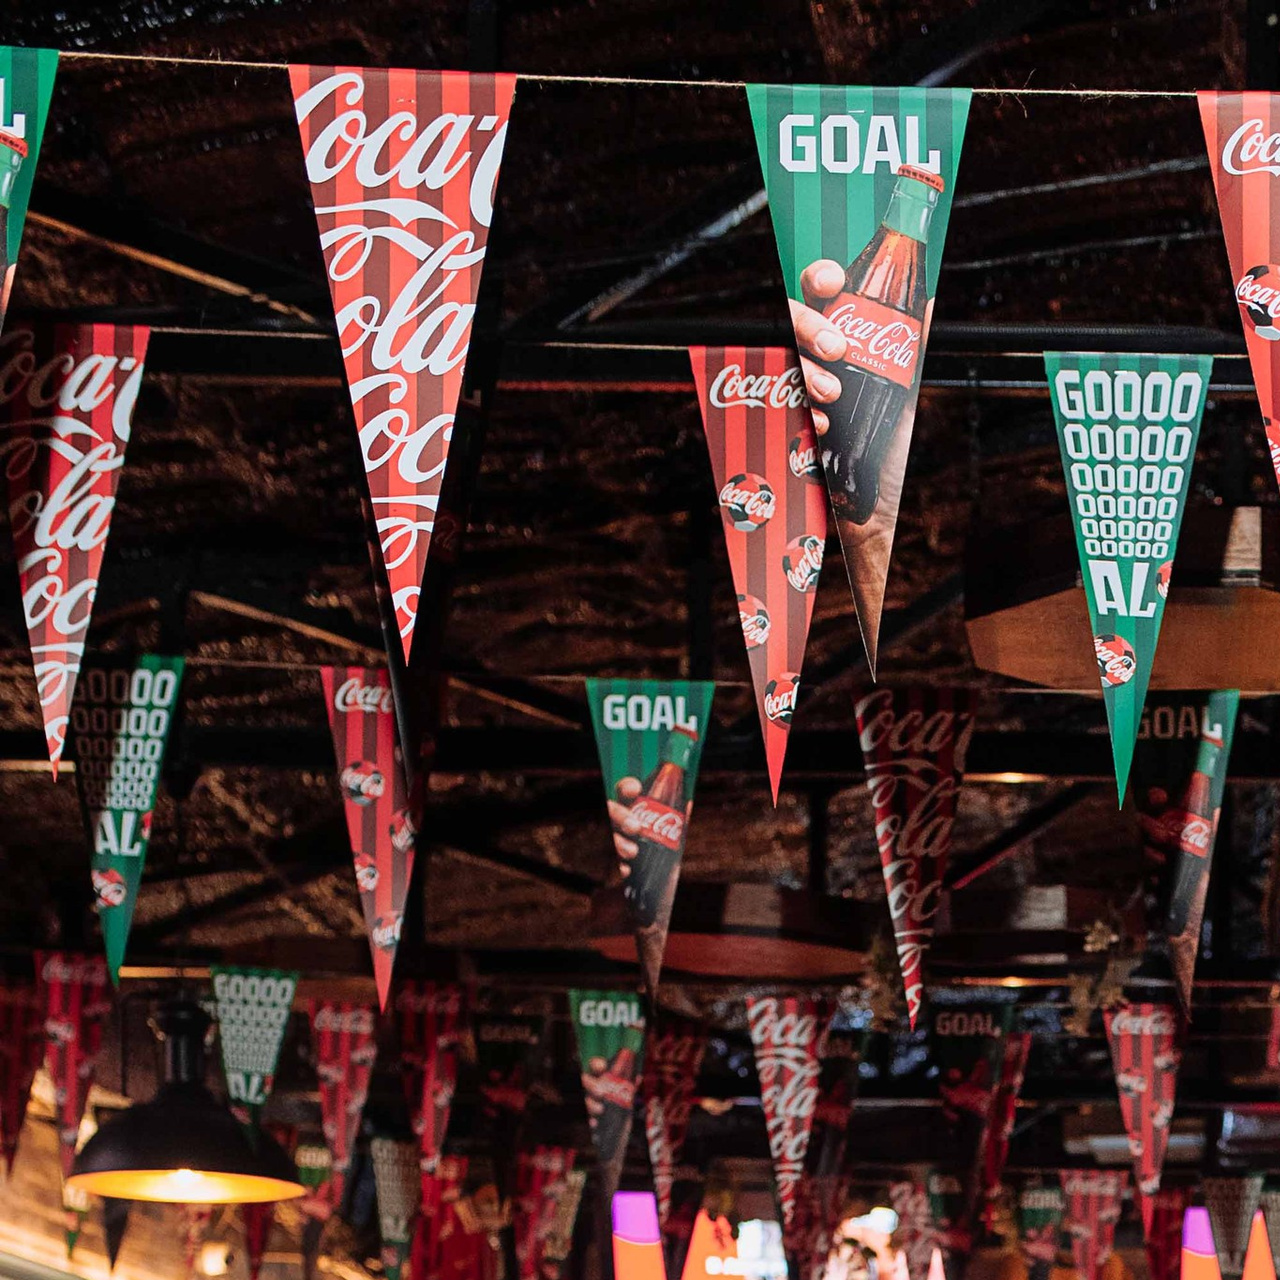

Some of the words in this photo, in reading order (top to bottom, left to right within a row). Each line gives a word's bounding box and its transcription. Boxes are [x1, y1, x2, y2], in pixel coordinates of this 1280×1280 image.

[779, 114, 941, 175] GOAL
[823, 300, 920, 372] Coca-Cola
[850, 350, 888, 371] CLASSIC
[1056, 370, 1202, 423] GOOOO
[1064, 424, 1193, 464] OOOOO
[1071, 463, 1186, 495] OOOOO
[1077, 493, 1179, 520] OOOOO
[1081, 518, 1173, 541] OOOOO
[1085, 538, 1168, 559] OOOOO
[1088, 560, 1157, 617] AL
[603, 694, 698, 731] GOAL
[580, 1000, 645, 1027] GOAL
